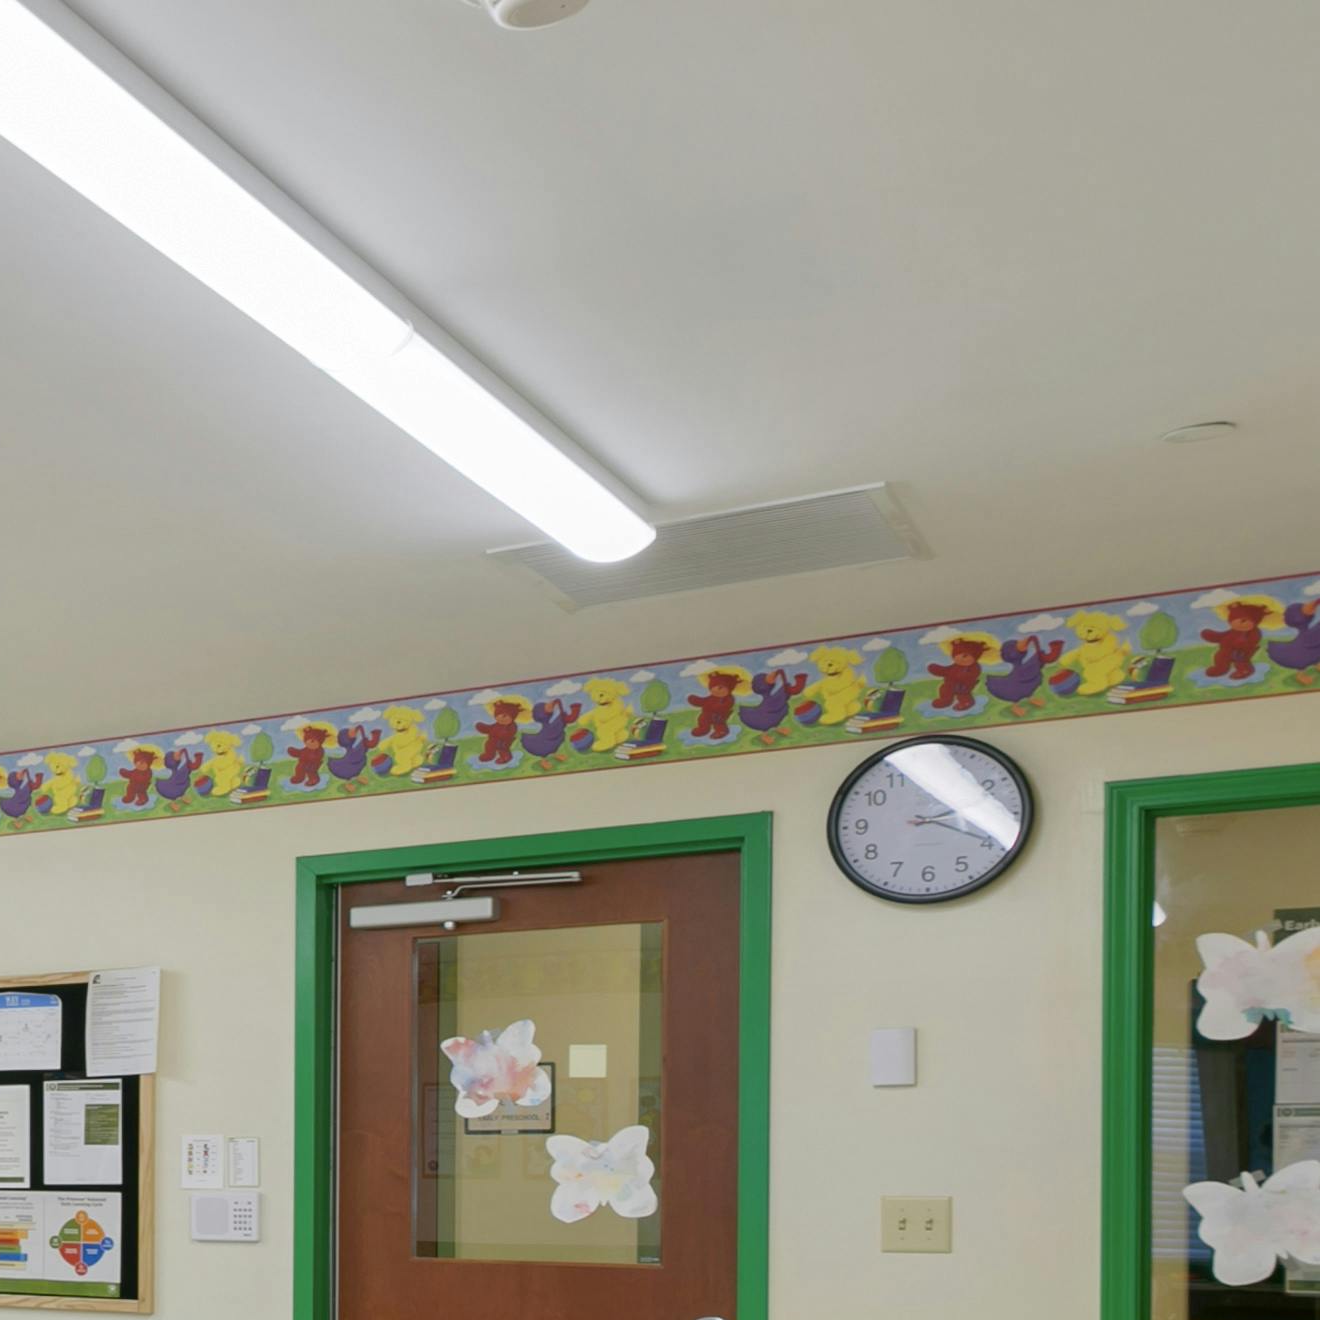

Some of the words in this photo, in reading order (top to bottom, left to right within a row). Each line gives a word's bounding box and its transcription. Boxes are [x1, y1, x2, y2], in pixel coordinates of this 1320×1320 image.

[886, 773, 905, 788] 11
[865, 789, 887, 806] 10
[855, 818, 868, 835] 9
[864, 844, 878, 860] 8
[890, 861, 904, 877] 7
[955, 856, 969, 872] 5
[921, 866, 935, 882] 6
